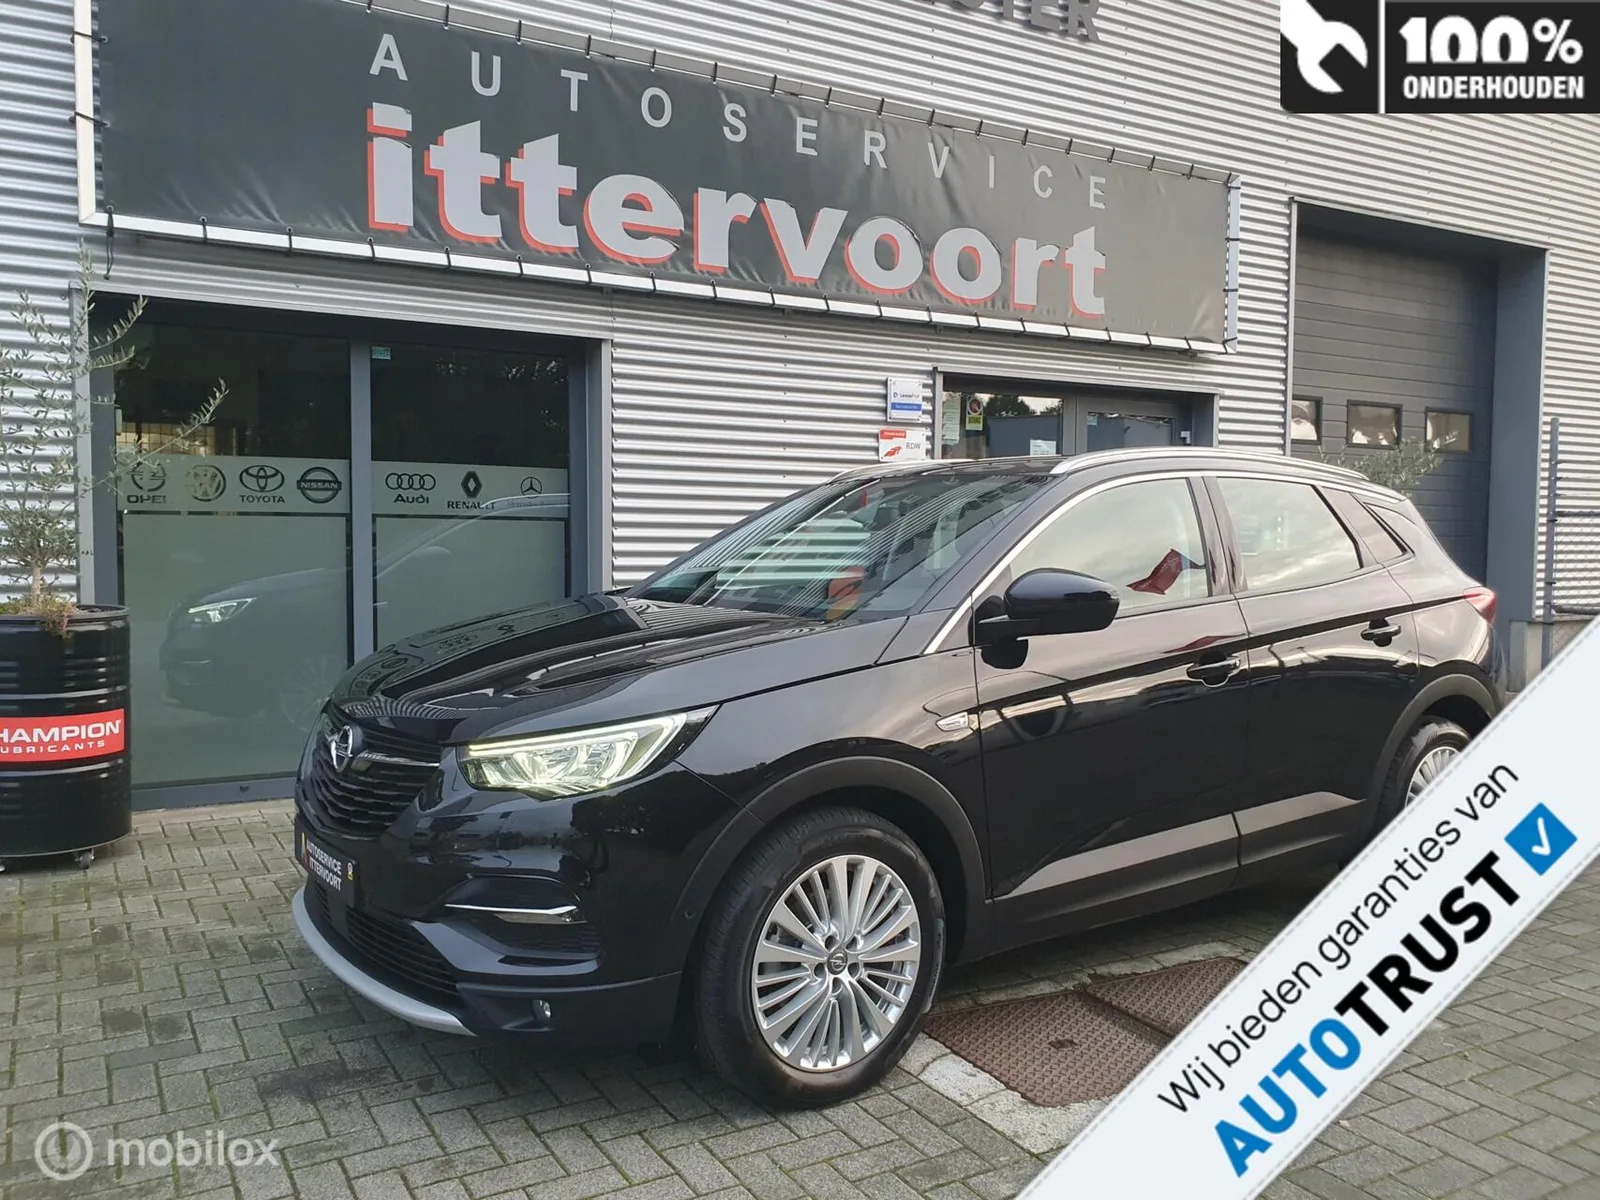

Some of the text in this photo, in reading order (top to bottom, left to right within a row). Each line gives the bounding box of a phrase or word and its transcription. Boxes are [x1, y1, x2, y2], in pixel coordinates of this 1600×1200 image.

[366, 102, 1107, 317] ittervoort
[905, 442, 921, 450] RDW
[300, 480, 339, 490] NISSAN
[239, 494, 286, 504] TOYOTA
[393, 493, 430, 504] Audi
[446, 500, 496, 510] RENAULT
[0, 720, 121, 743] HAMPION
[0, 739, 106, 754] UBRICANTS
